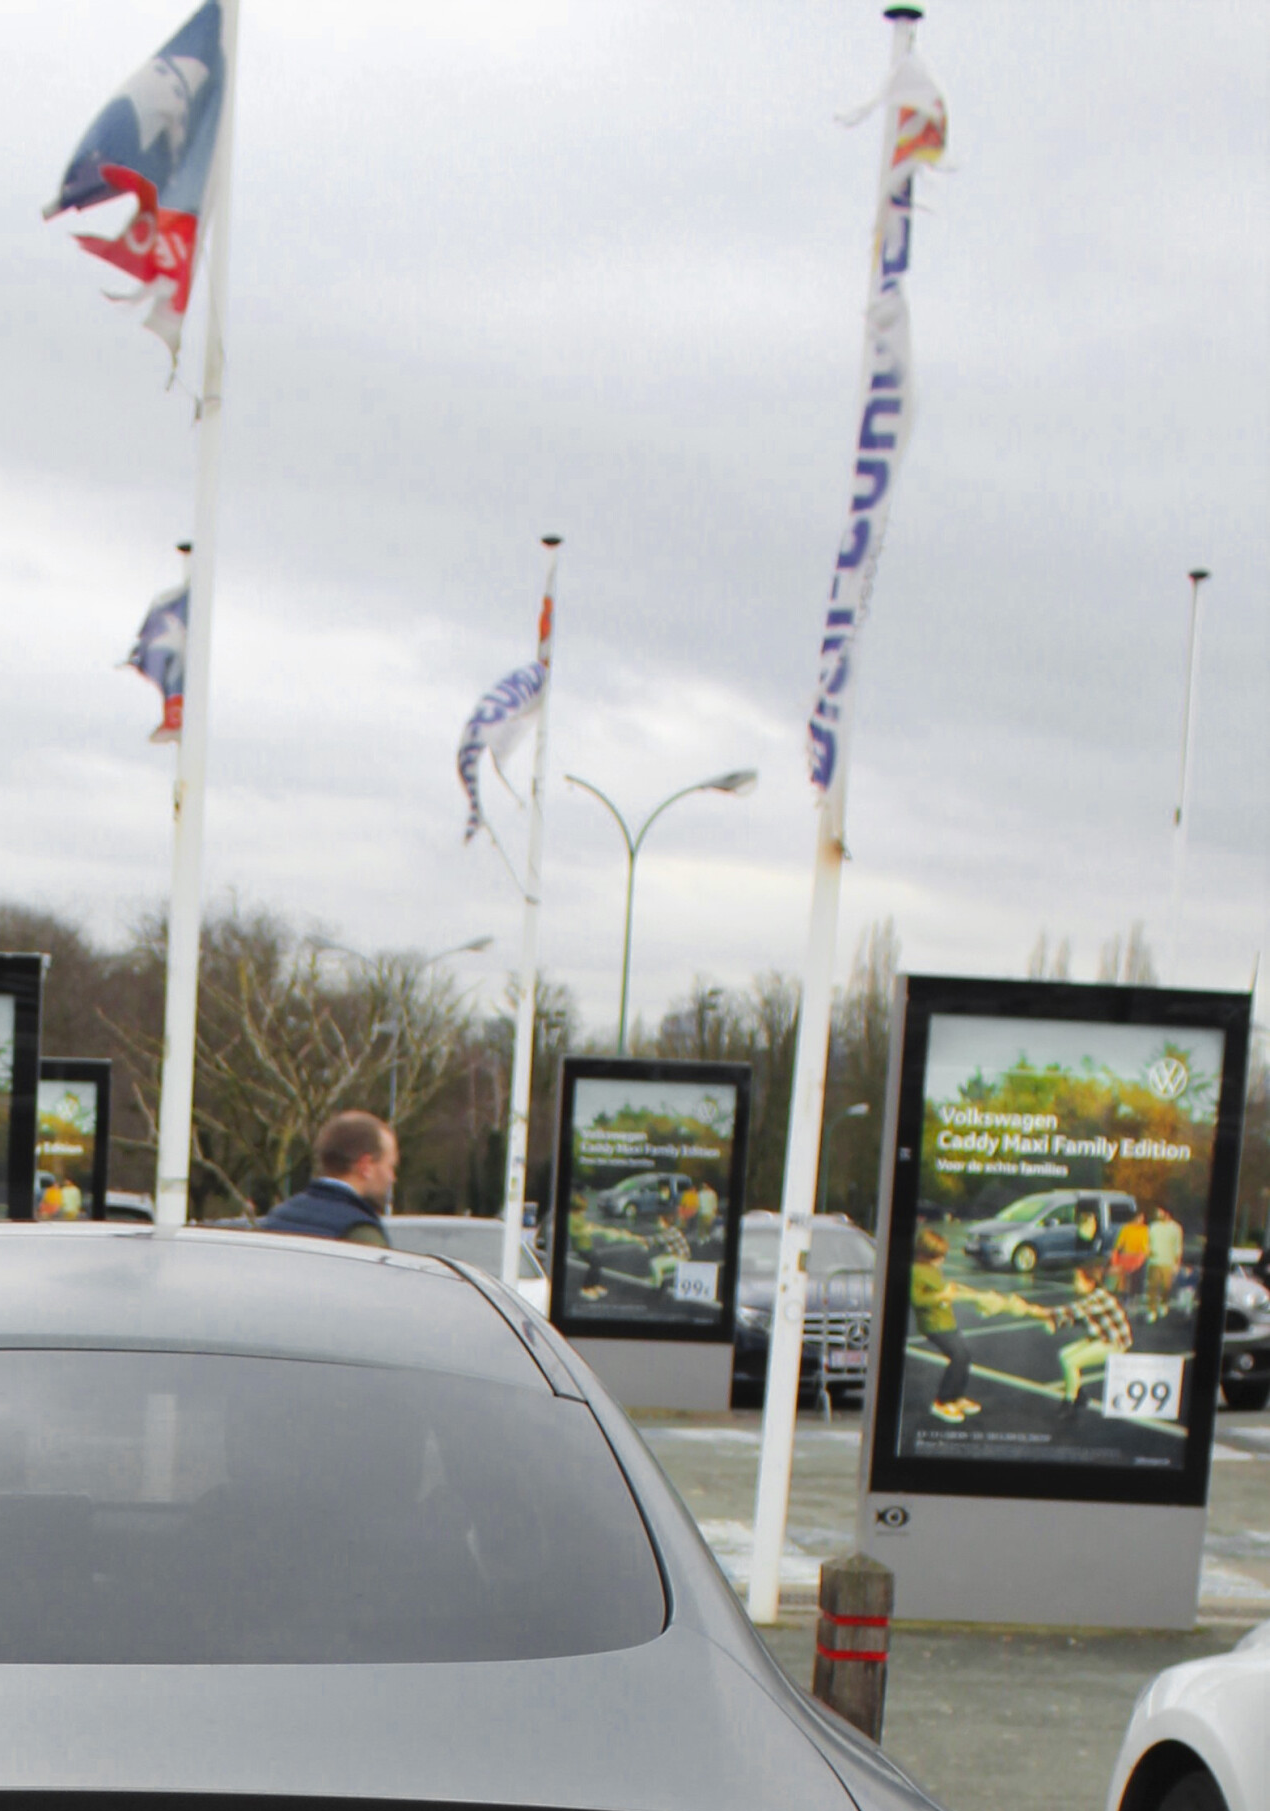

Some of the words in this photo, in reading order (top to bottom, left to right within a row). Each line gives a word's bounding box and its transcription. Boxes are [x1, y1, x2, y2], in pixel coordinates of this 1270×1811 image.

[939, 1106, 1058, 1133] Volkswagen
[937, 1131, 999, 1157] Caddy
[1003, 1134, 1049, 1154] Maxi
[1052, 1135, 1119, 1162] Family
[1121, 1139, 1191, 1161] Edition
[936, 1159, 964, 1172] Voor
[966, 1159, 983, 1173] de
[985, 1161, 1017, 1174] echte
[1020, 1159, 1068, 1177] families
